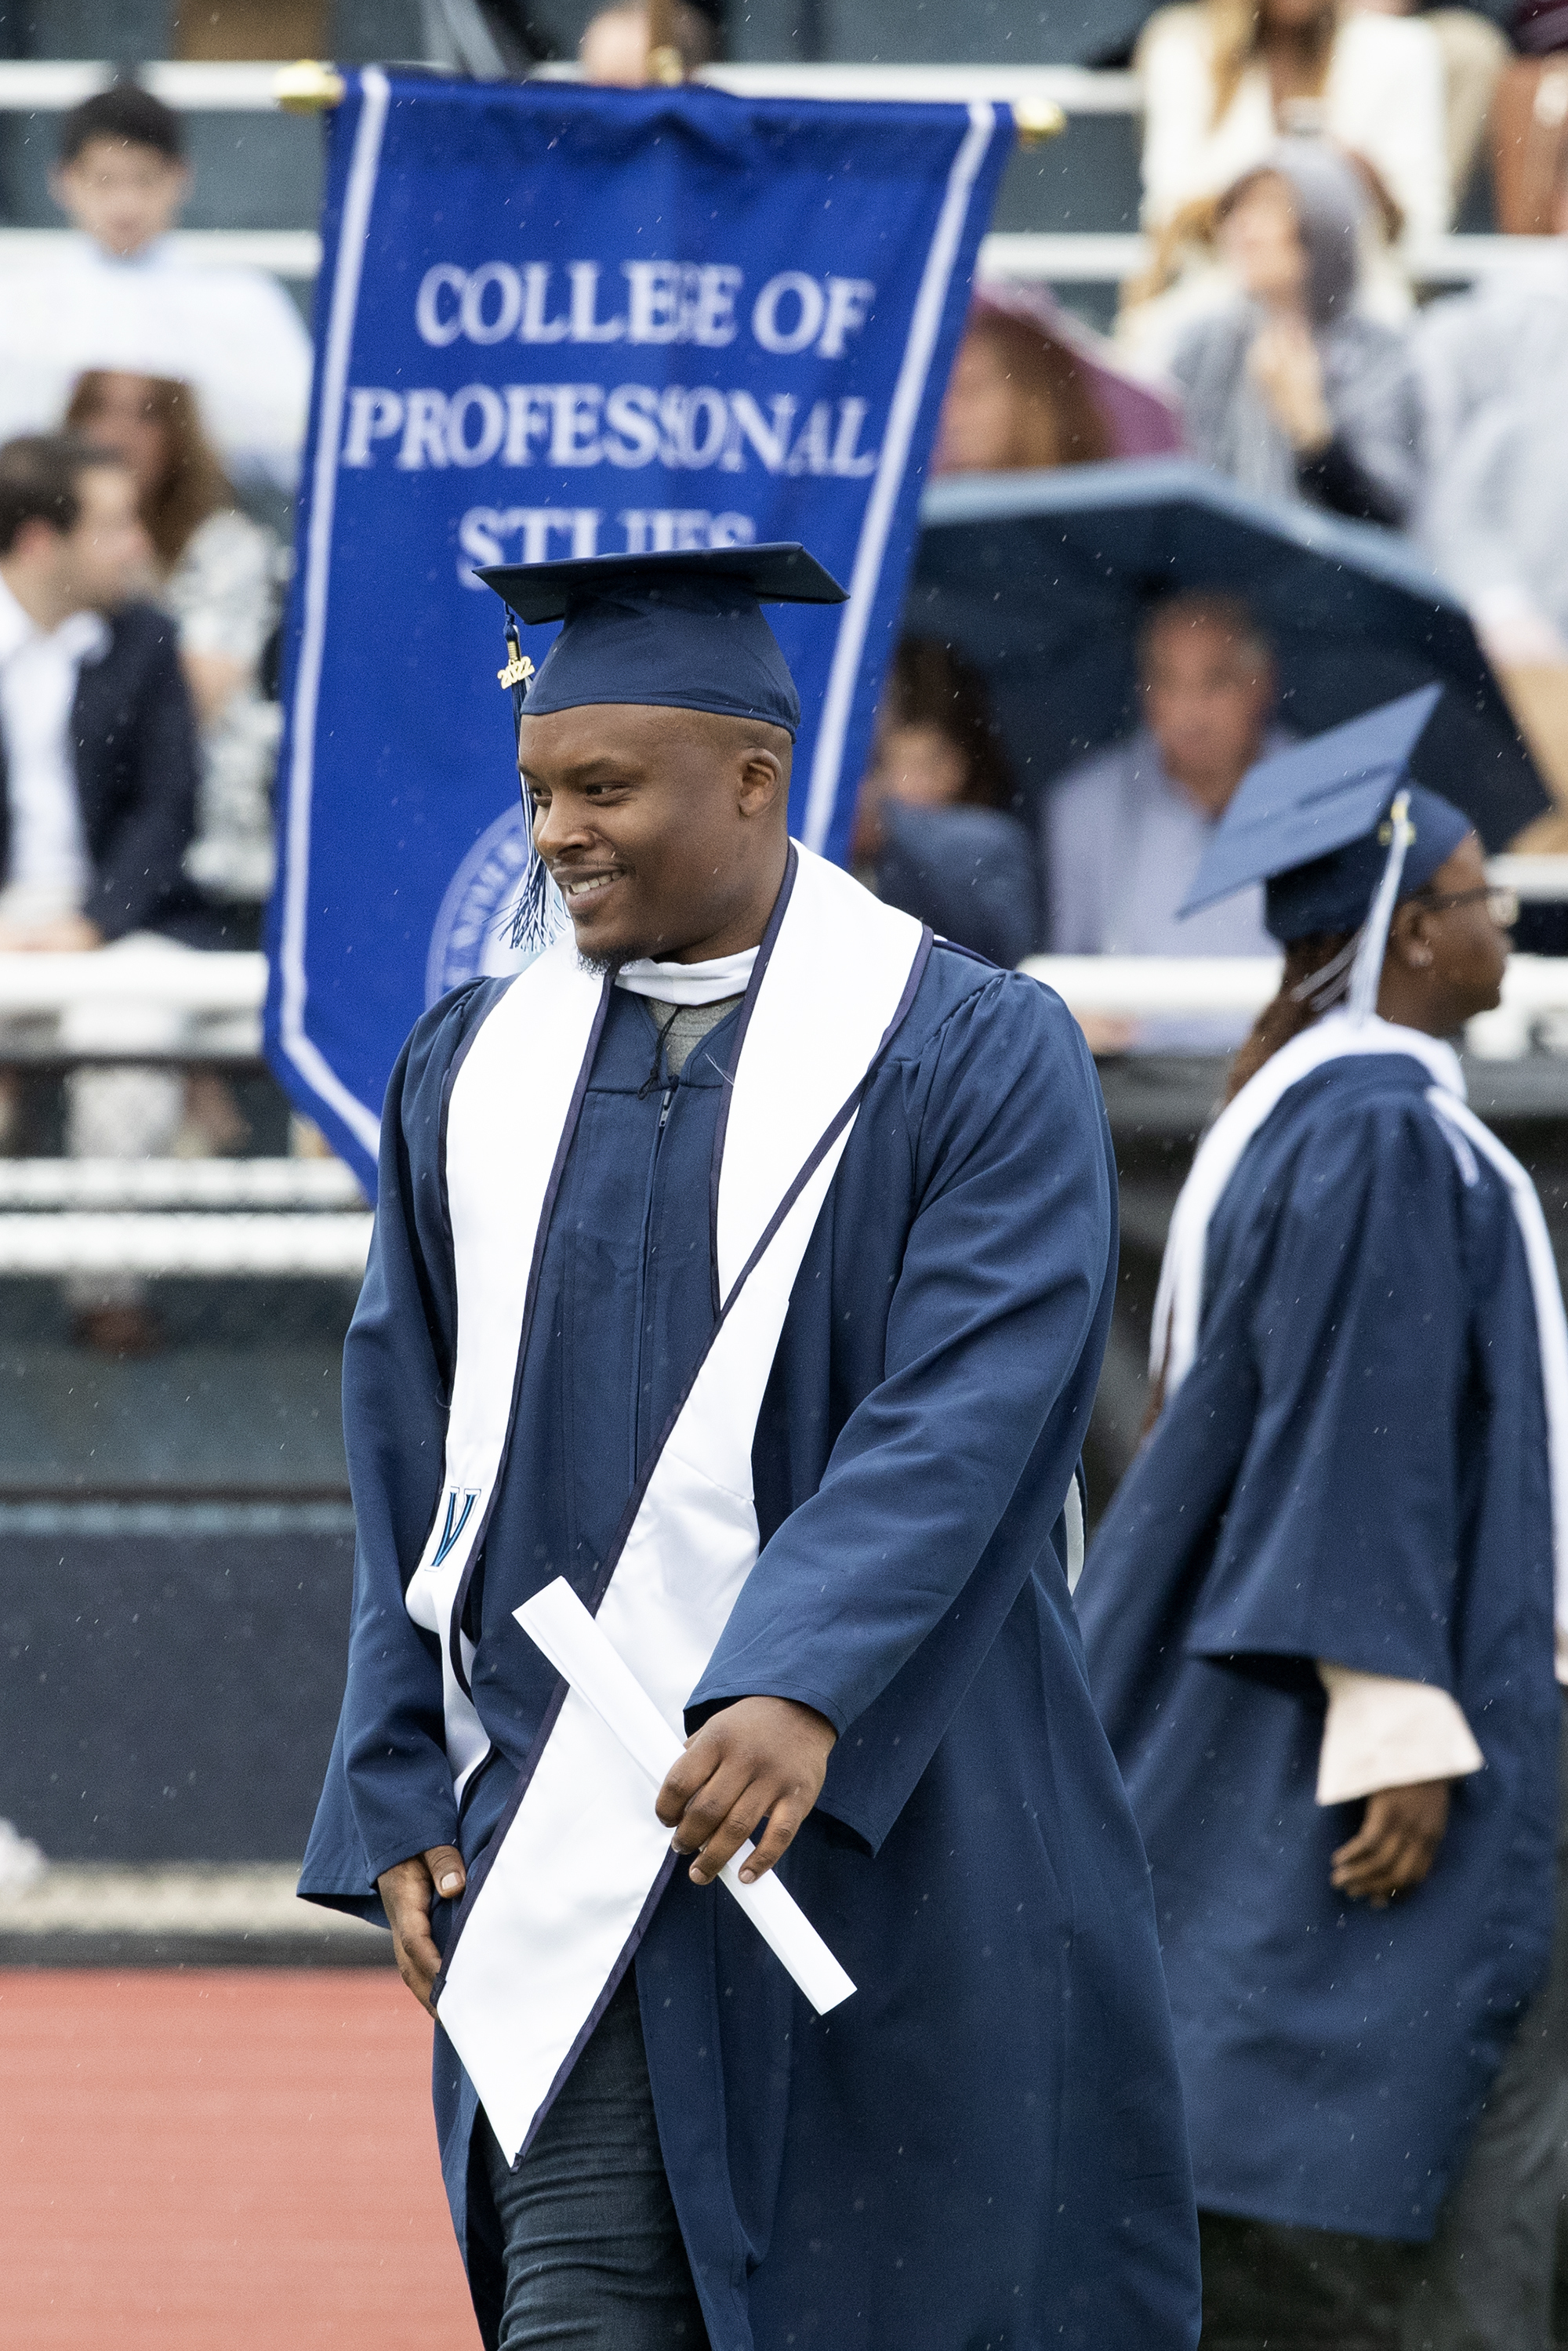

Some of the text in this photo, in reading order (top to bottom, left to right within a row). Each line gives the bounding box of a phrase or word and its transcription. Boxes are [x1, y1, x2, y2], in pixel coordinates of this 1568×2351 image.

[750, 270, 877, 359] OF
[342, 382, 878, 480] PROFESSONAL
[497, 655, 535, 689] 2022
